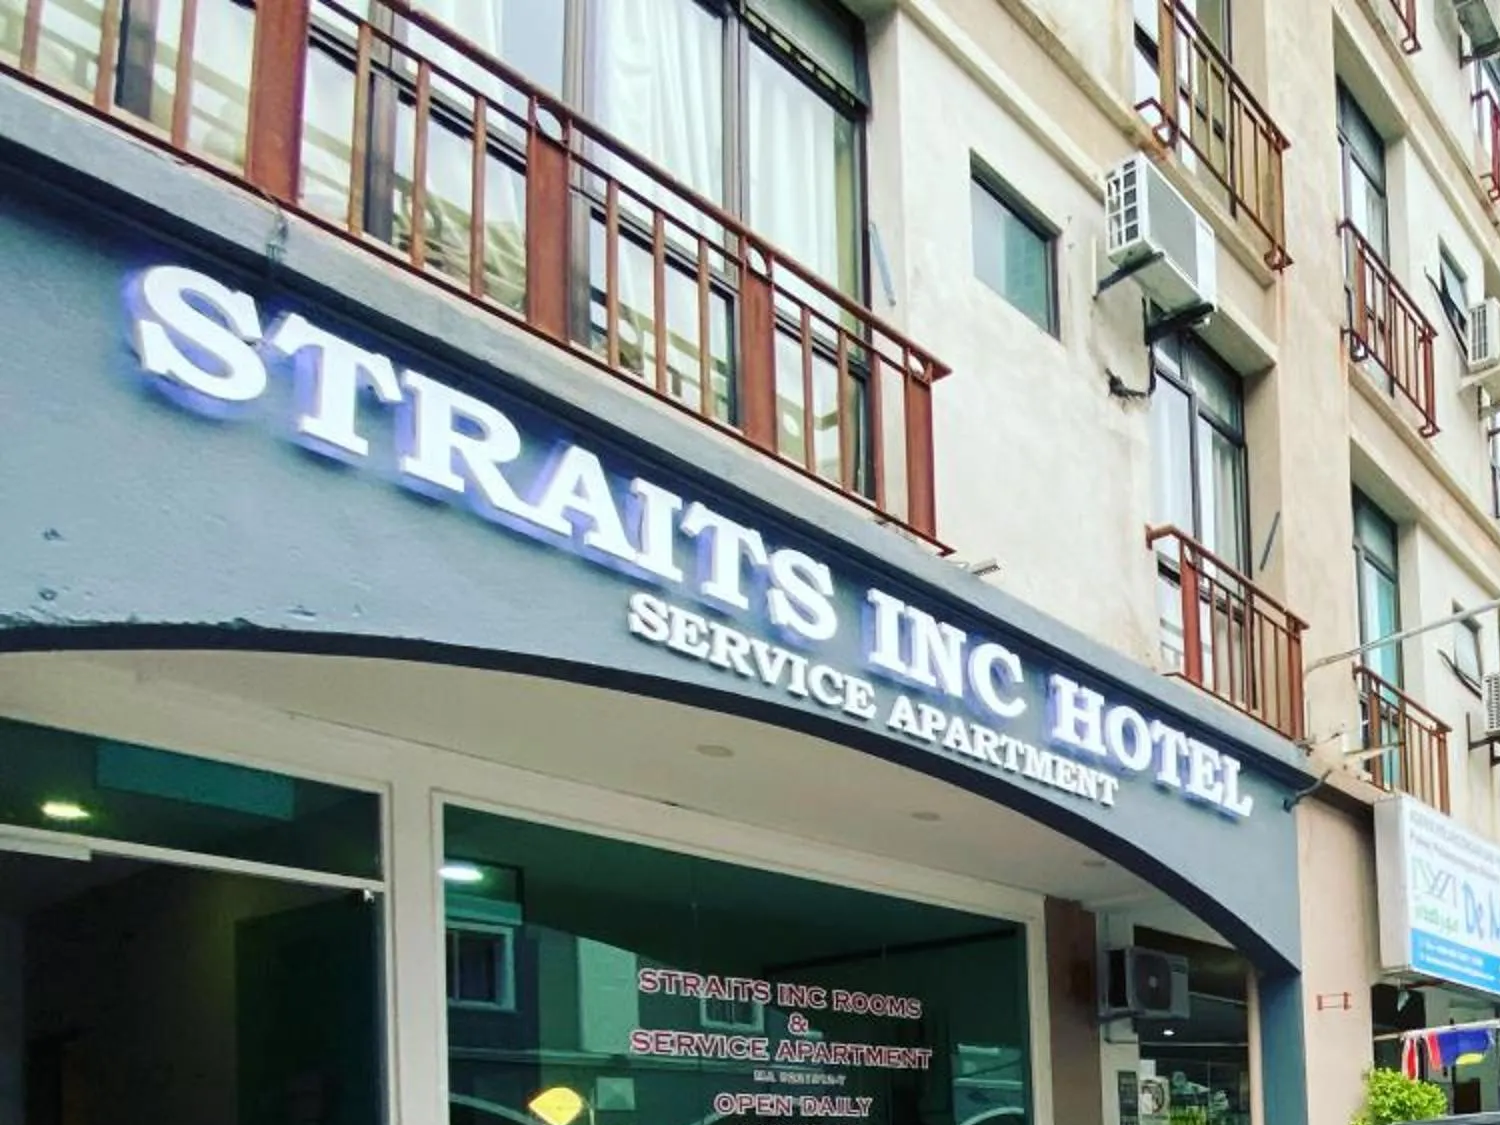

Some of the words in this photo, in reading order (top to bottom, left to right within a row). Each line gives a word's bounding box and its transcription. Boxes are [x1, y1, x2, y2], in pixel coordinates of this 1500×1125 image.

[138, 265, 838, 642] STRAITS
[867, 587, 1026, 718] INC
[1050, 673, 1253, 818] HOTEL
[628, 592, 876, 719] SERVICE
[887, 695, 1118, 807] APARTMENT
[639, 968, 770, 1004] STRAITS
[777, 983, 827, 1009] INC
[832, 990, 922, 1018] ROOMS
[788, 1012, 809, 1034] &
[630, 1030, 769, 1061] SERVICE
[775, 1039, 933, 1070] APARTMENT
[714, 1093, 793, 1117] OPEN
[800, 1096, 873, 1118] DAILY
